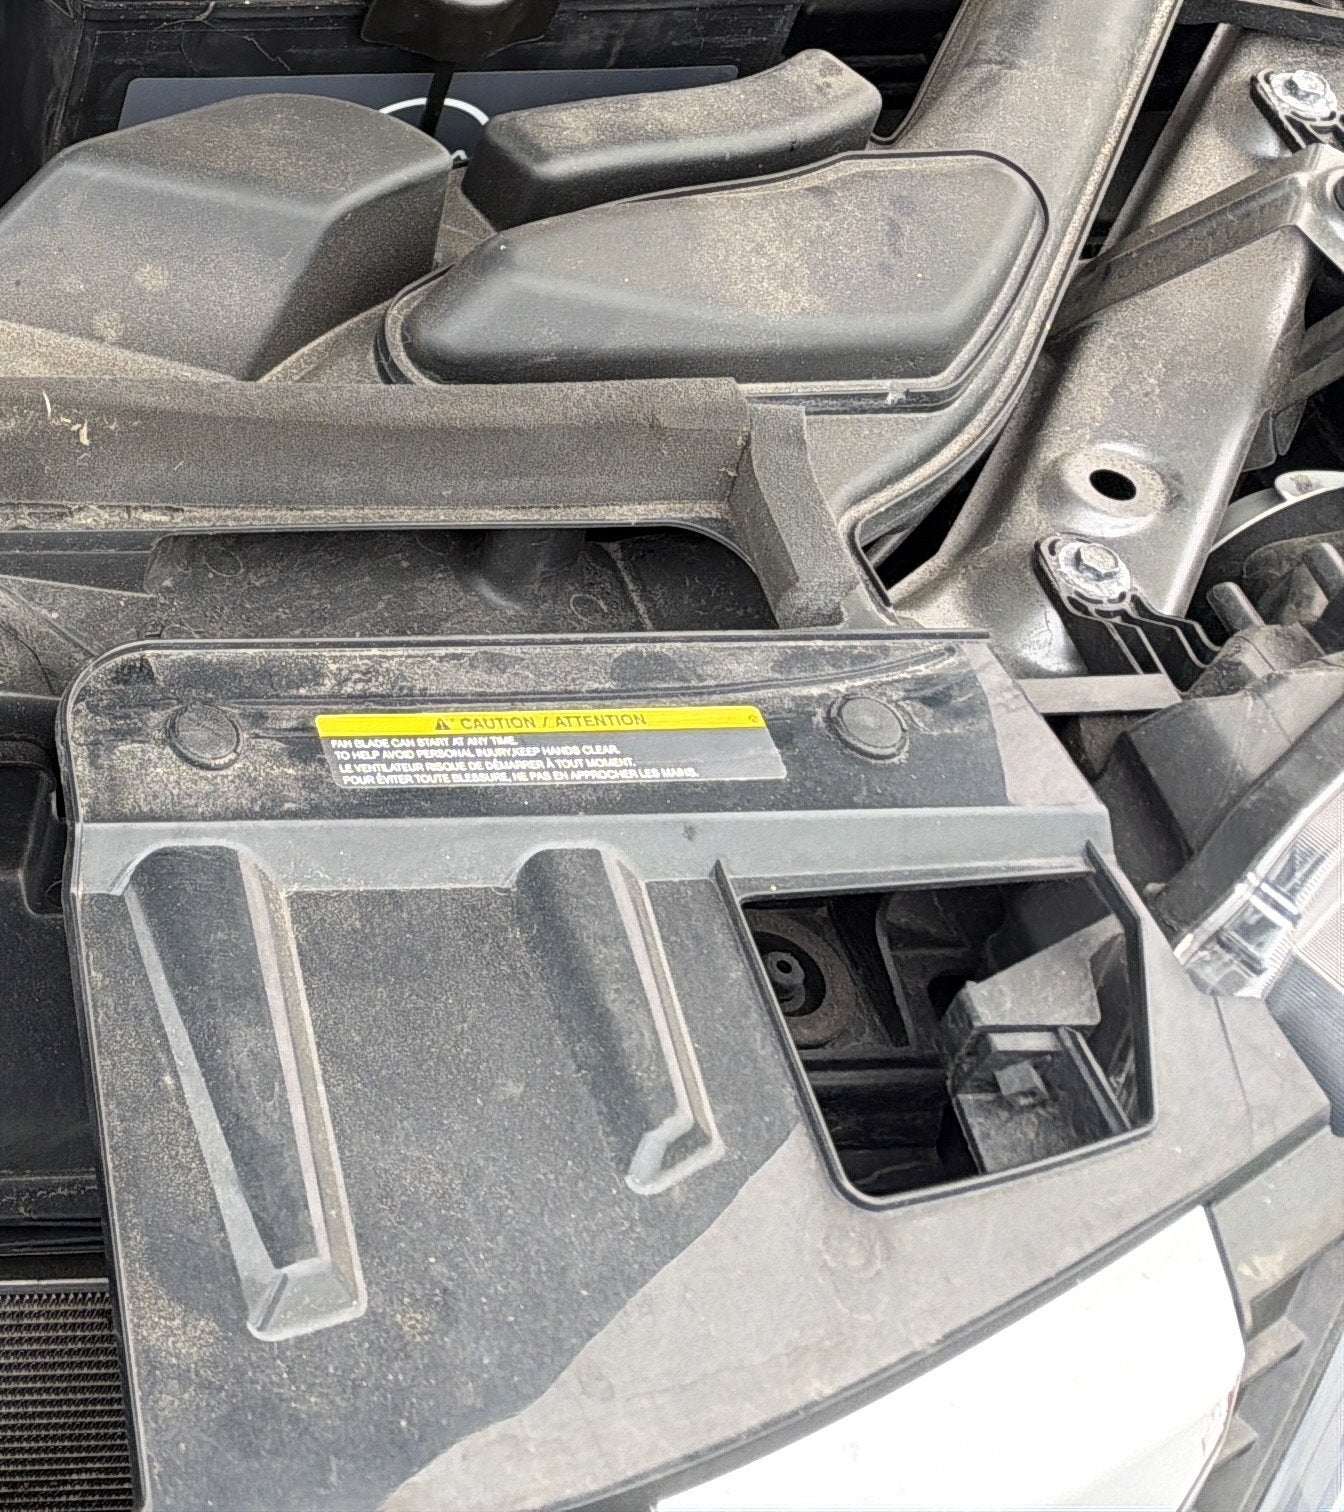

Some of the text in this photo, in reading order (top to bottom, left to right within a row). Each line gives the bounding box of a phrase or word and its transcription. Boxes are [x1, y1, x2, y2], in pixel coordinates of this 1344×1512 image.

[460, 716, 536, 730] CAUTION
[555, 713, 648, 728] ATTENTION
[331, 739, 353, 748] FAN
[354, 738, 390, 748] BLADE
[391, 738, 416, 748] CAN
[417, 737, 450, 747] START
[452, 737, 465, 747] AT
[467, 737, 490, 746] ANY
[335, 751, 350, 761] TO
[352, 750, 381, 760] HELP
[382, 750, 415, 760] AVOID
[416, 749, 475, 759] PERSONAL
[542, 745, 581, 756] HANDS
[339, 763, 354, 773] LE
[354, 762, 425, 773] VENTILATEUR
[426, 761, 467, 772] RISQUE
[468, 760, 484, 771] DE
[556, 759, 584, 768] TOUT
[343, 774, 375, 785] POUR
[376, 772, 413, 785] ÉVITER
[415, 773, 452, 784] TOUTE
[513, 772, 529, 782] NE
[530, 771, 552, 782] PAS
[553, 770, 569, 781] EN
[570, 768, 639, 780] APPROCHER
[639, 768, 659, 779] LES
